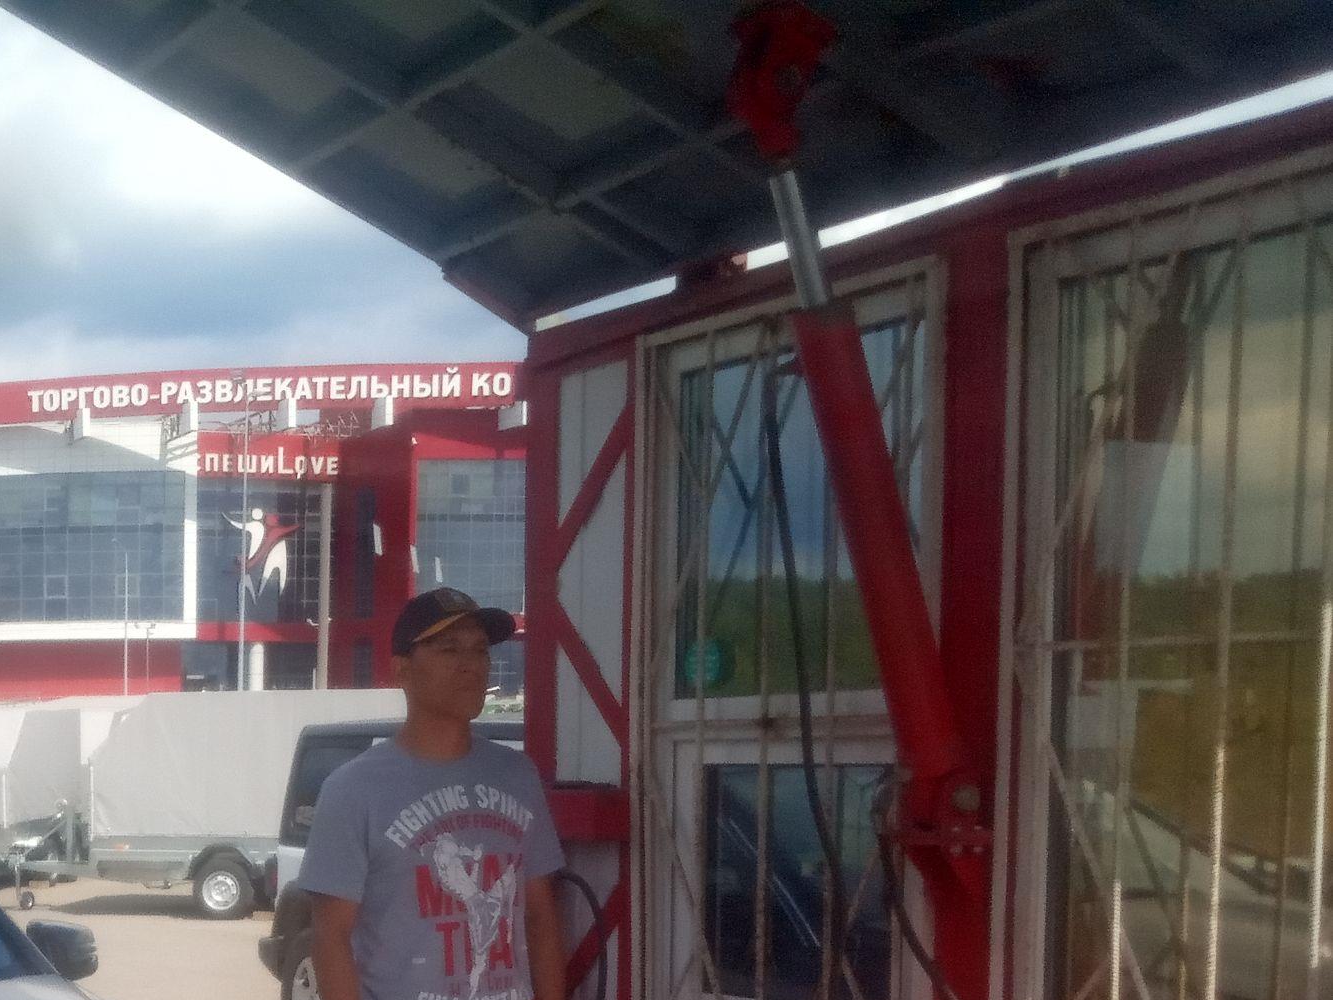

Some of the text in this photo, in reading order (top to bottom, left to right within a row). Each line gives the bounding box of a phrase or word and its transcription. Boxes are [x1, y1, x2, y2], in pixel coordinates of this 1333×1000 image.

[28, 367, 462, 412] ТОРГОВО-РАЗВЛЕКАТЕЛЬНЫЙ
[384, 784, 534, 849] FIGHTING SPIRIT
